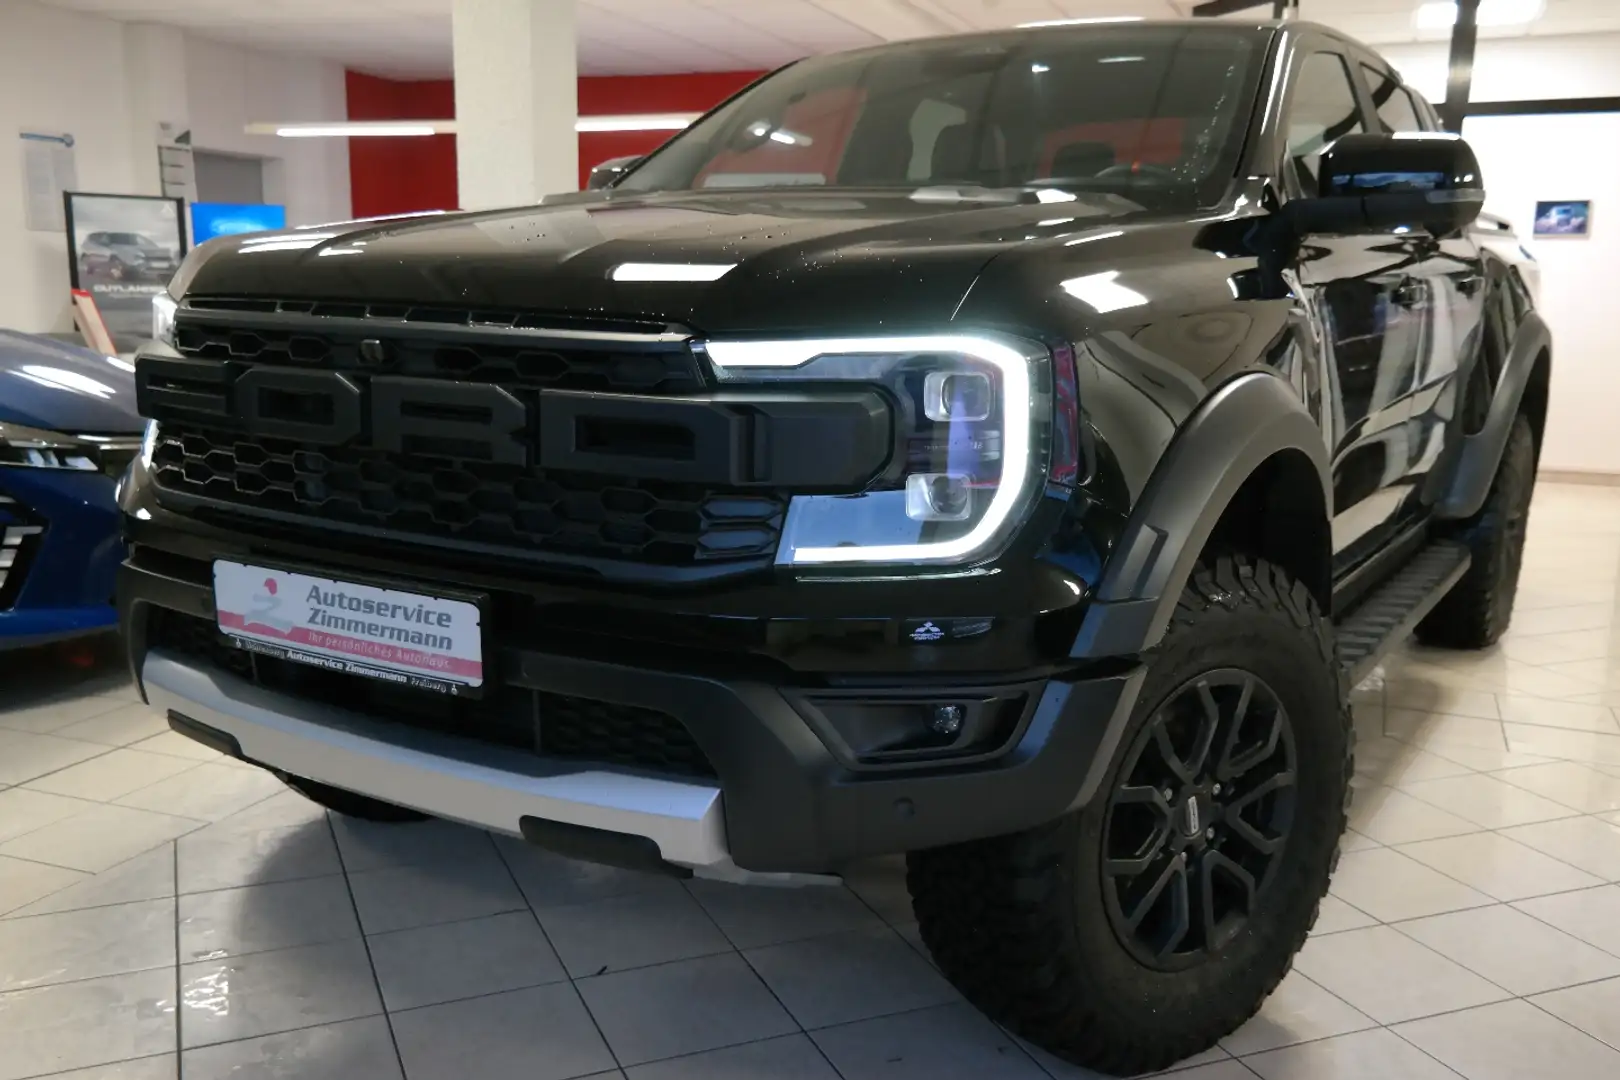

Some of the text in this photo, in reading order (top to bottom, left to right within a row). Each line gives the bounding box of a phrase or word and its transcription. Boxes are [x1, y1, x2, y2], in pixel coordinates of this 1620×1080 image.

[136, 356, 742, 482] FORD
[306, 584, 452, 628] Autoservice
[307, 606, 453, 651] Zimmermann
[308, 631, 451, 670] Ihr persönliches Autohaus
[286, 650, 343, 670] Autoservice
[345, 661, 408, 683] Zimmermann
